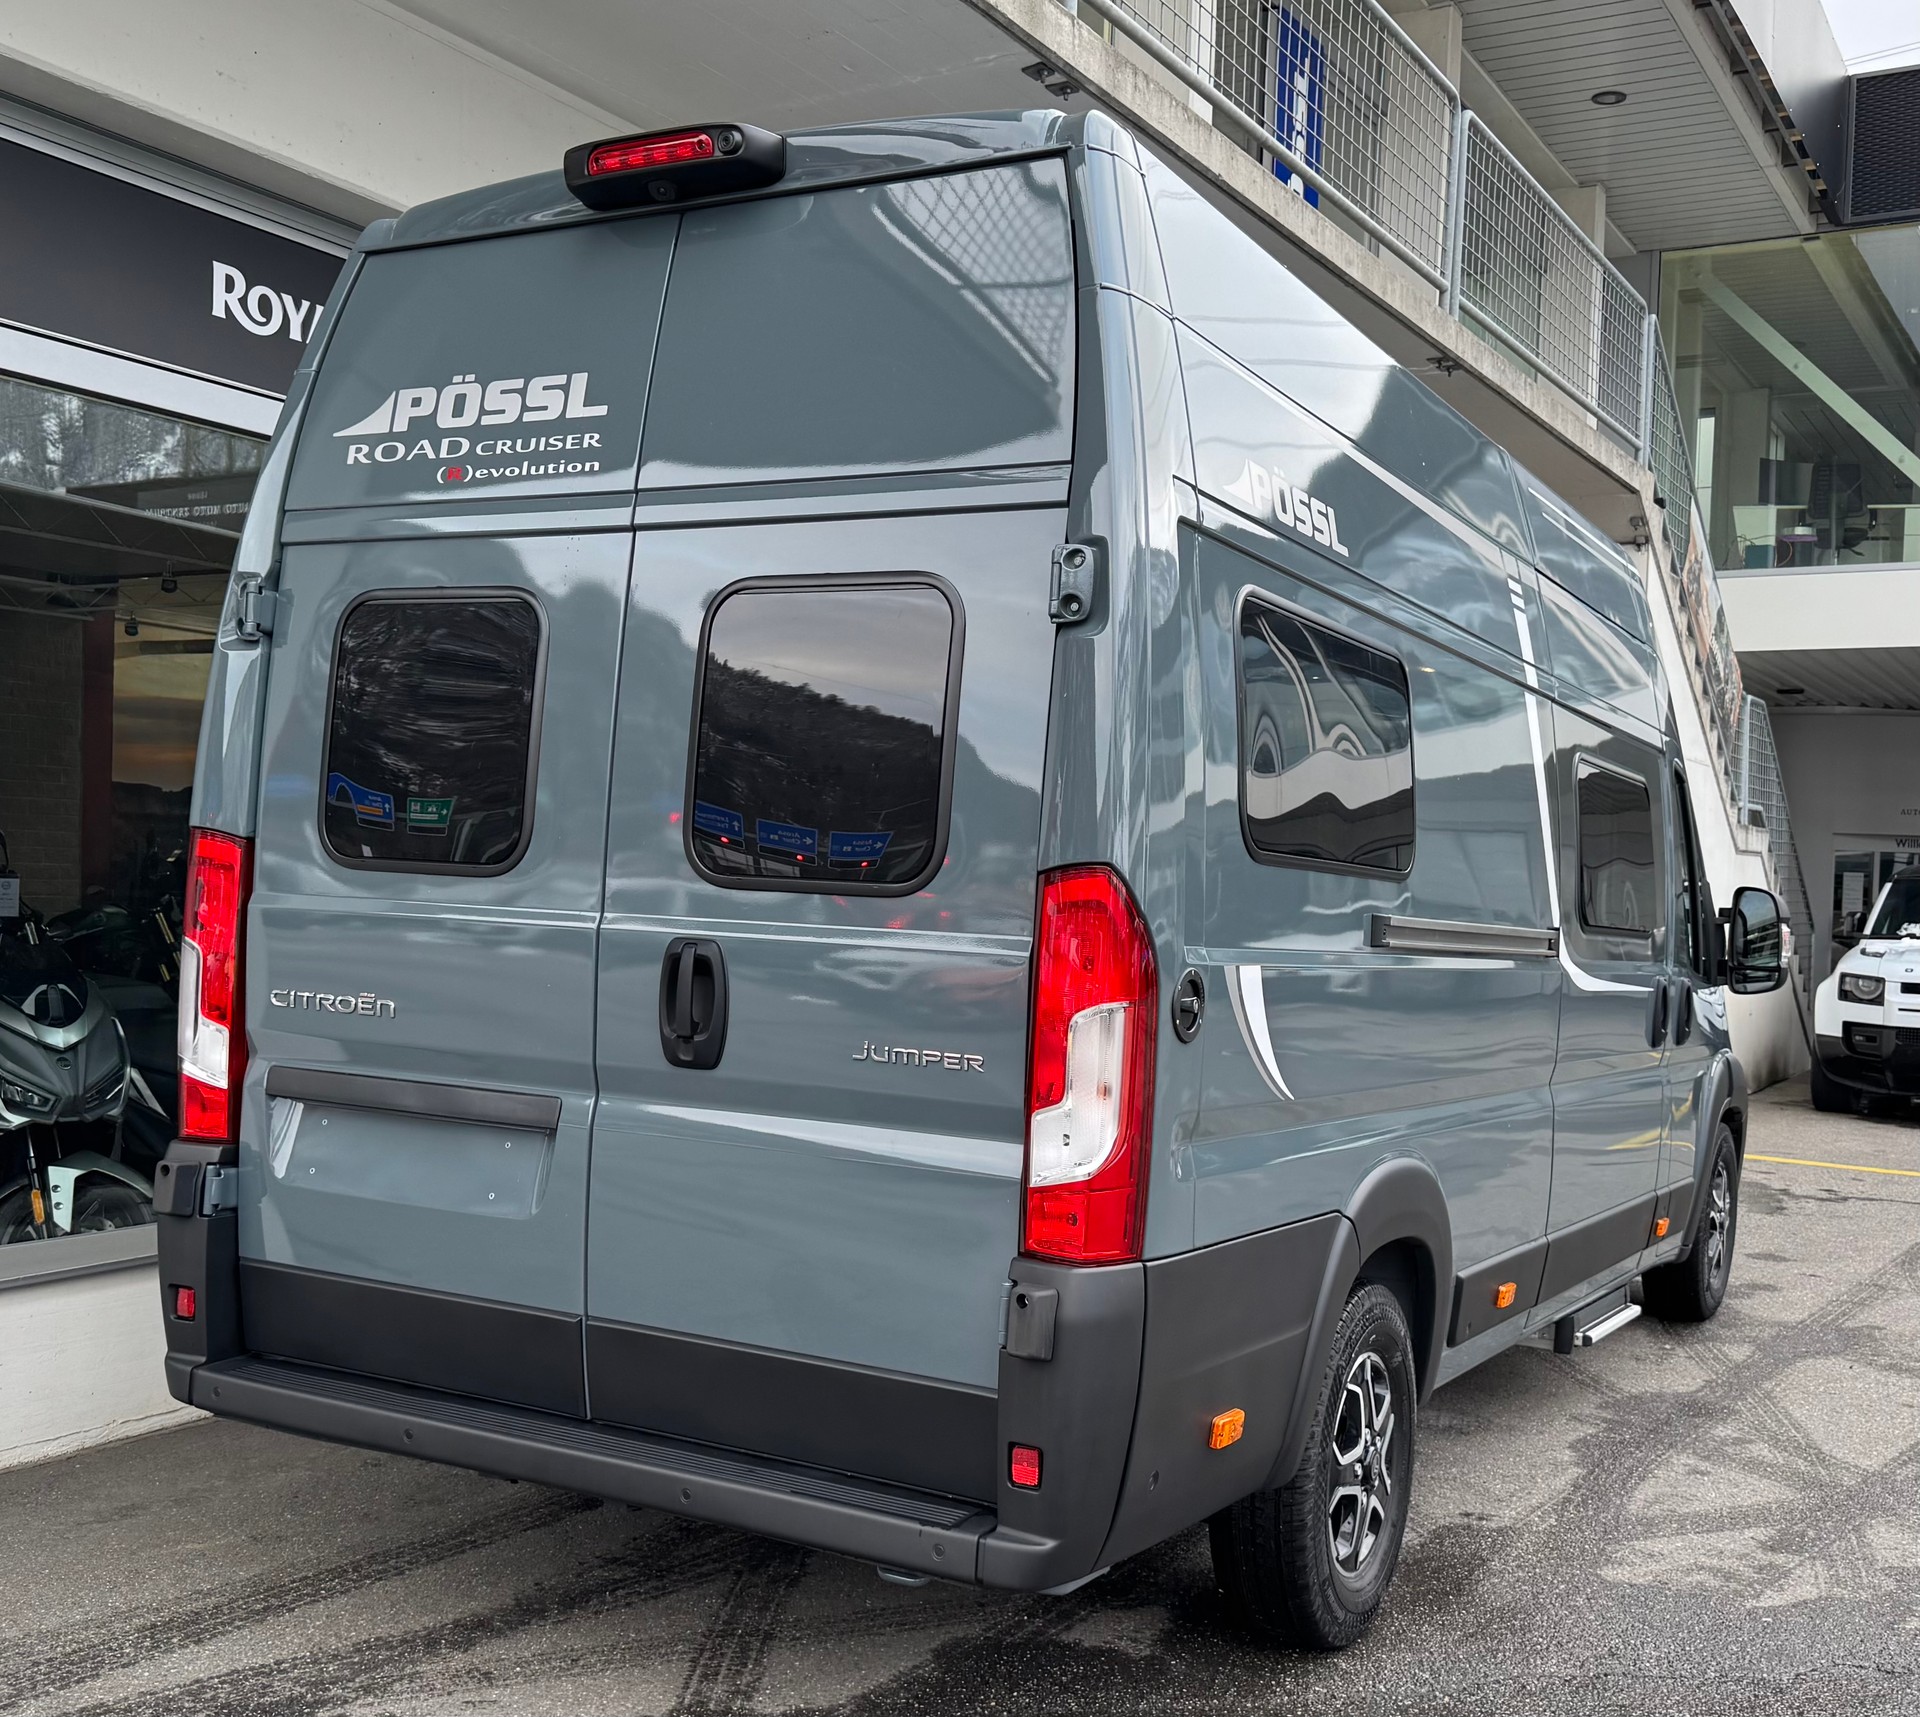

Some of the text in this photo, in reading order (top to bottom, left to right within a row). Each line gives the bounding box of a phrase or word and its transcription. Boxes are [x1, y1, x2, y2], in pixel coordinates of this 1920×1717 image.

[392, 372, 608, 433] PÖSSL
[346, 432, 602, 465] ROAD CRUISER
[436, 460, 600, 483] (R)evolution
[1249, 459, 1350, 558] PÖSSL
[270, 988, 397, 1018] CITROËN
[852, 1040, 985, 1074] JUMPER
